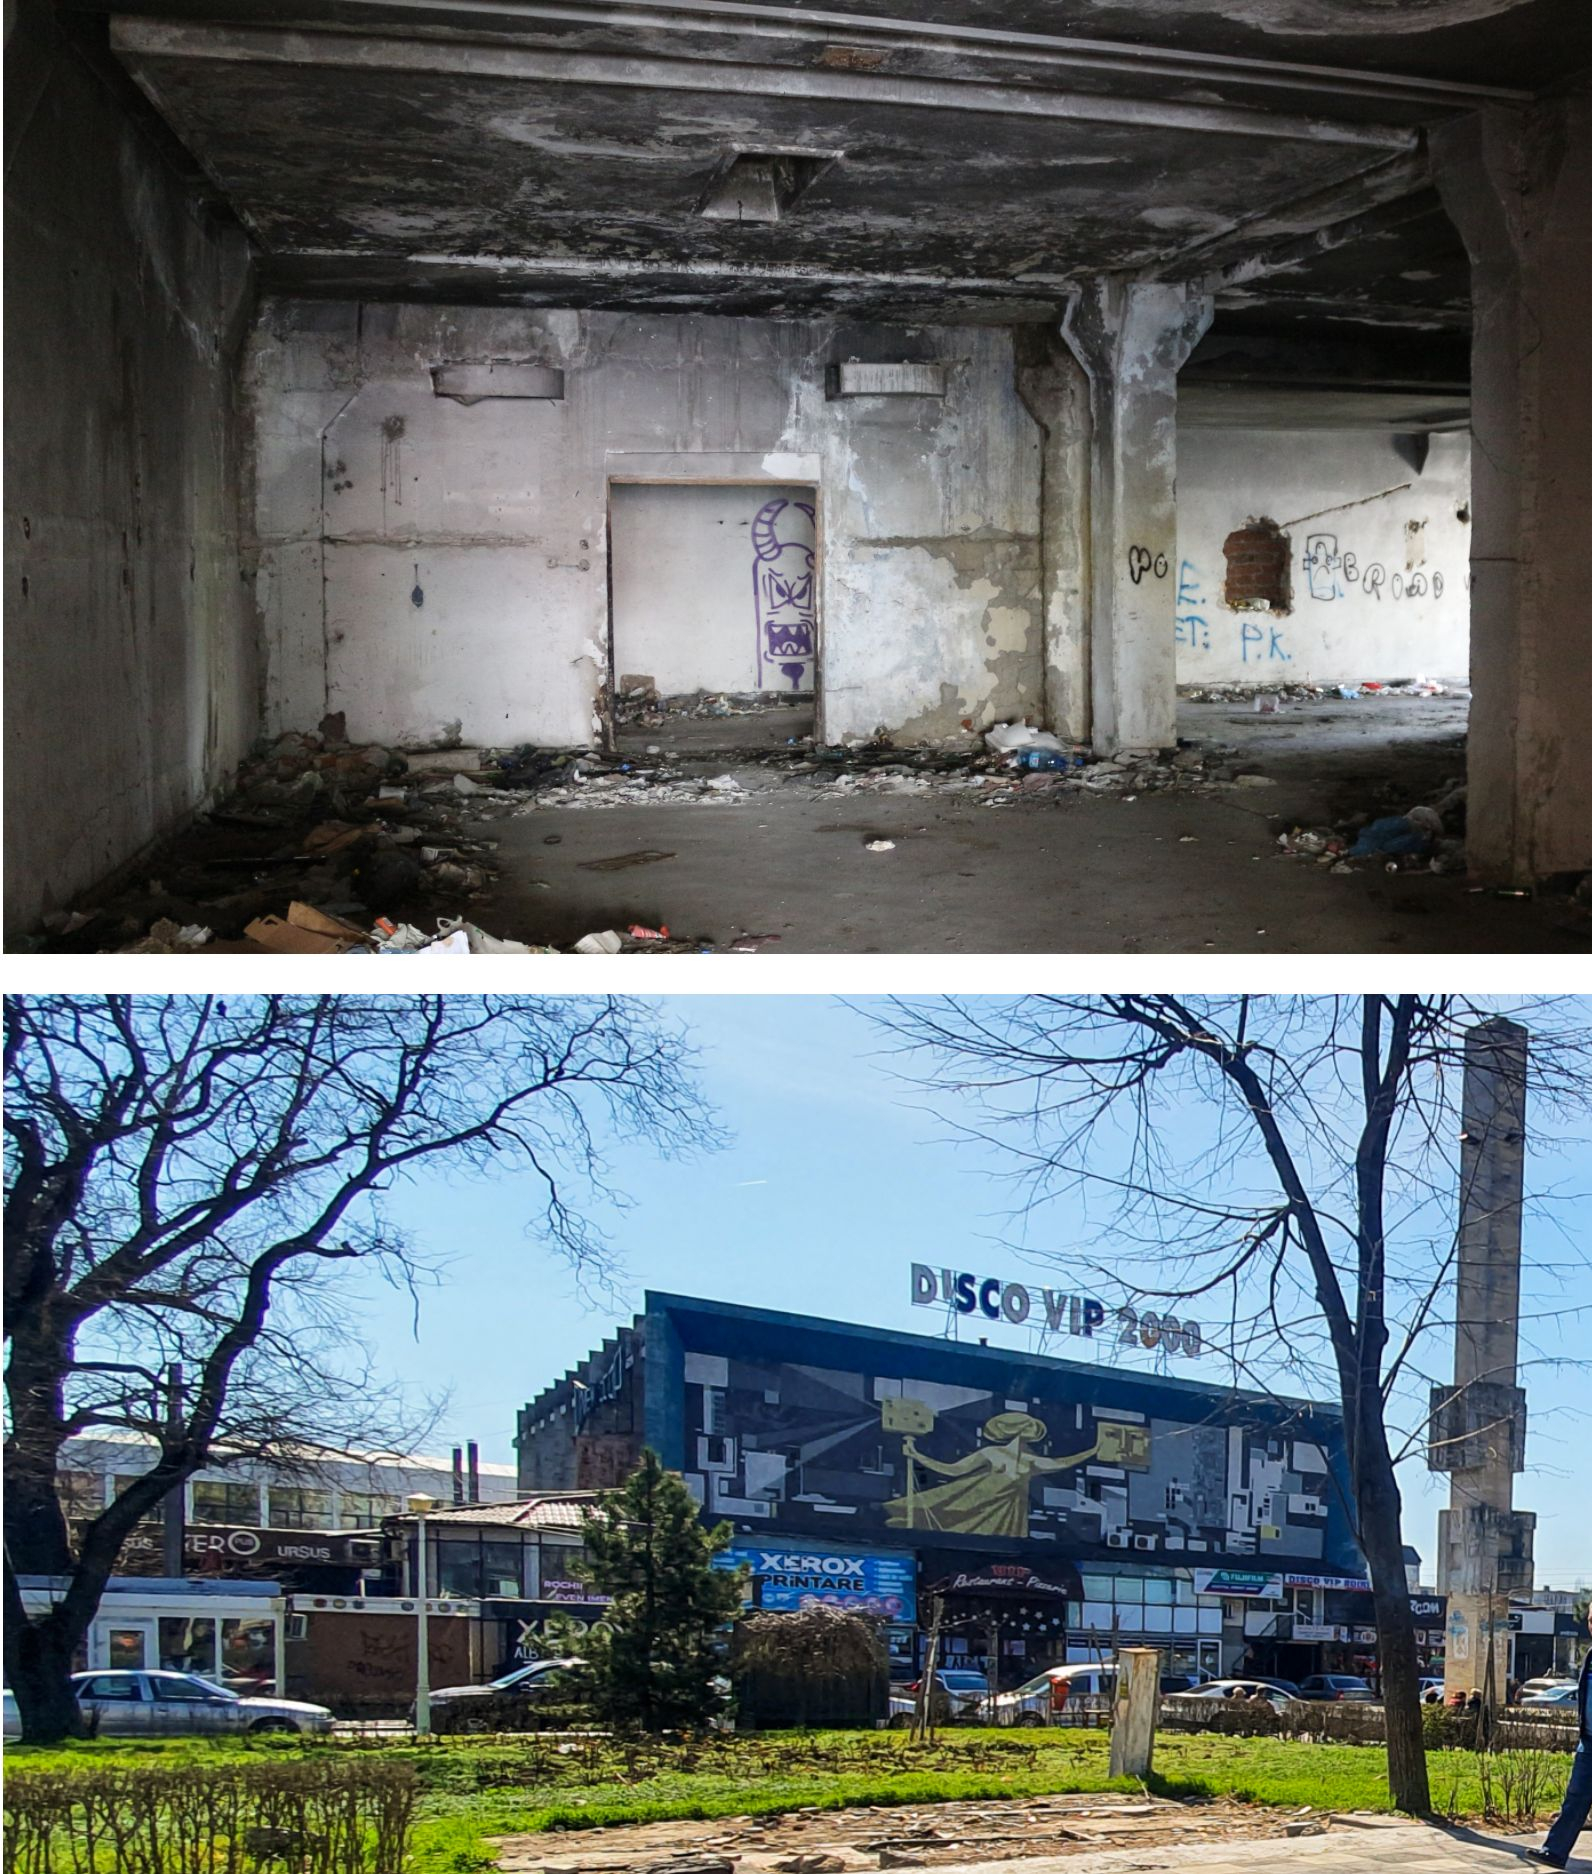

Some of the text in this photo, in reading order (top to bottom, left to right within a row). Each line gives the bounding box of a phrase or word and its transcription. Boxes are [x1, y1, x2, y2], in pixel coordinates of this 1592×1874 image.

[911, 1262, 1201, 1360] DISCO VIP 2000
[277, 1545, 331, 1559] URSUS
[759, 1552, 865, 1577] XEROX
[953, 1574, 1014, 1589] Restaurant
[1230, 1572, 1264, 1582] FUJIFILM
[1288, 1574, 1320, 1585] DISCO
[1323, 1576, 1341, 1587] VIP
